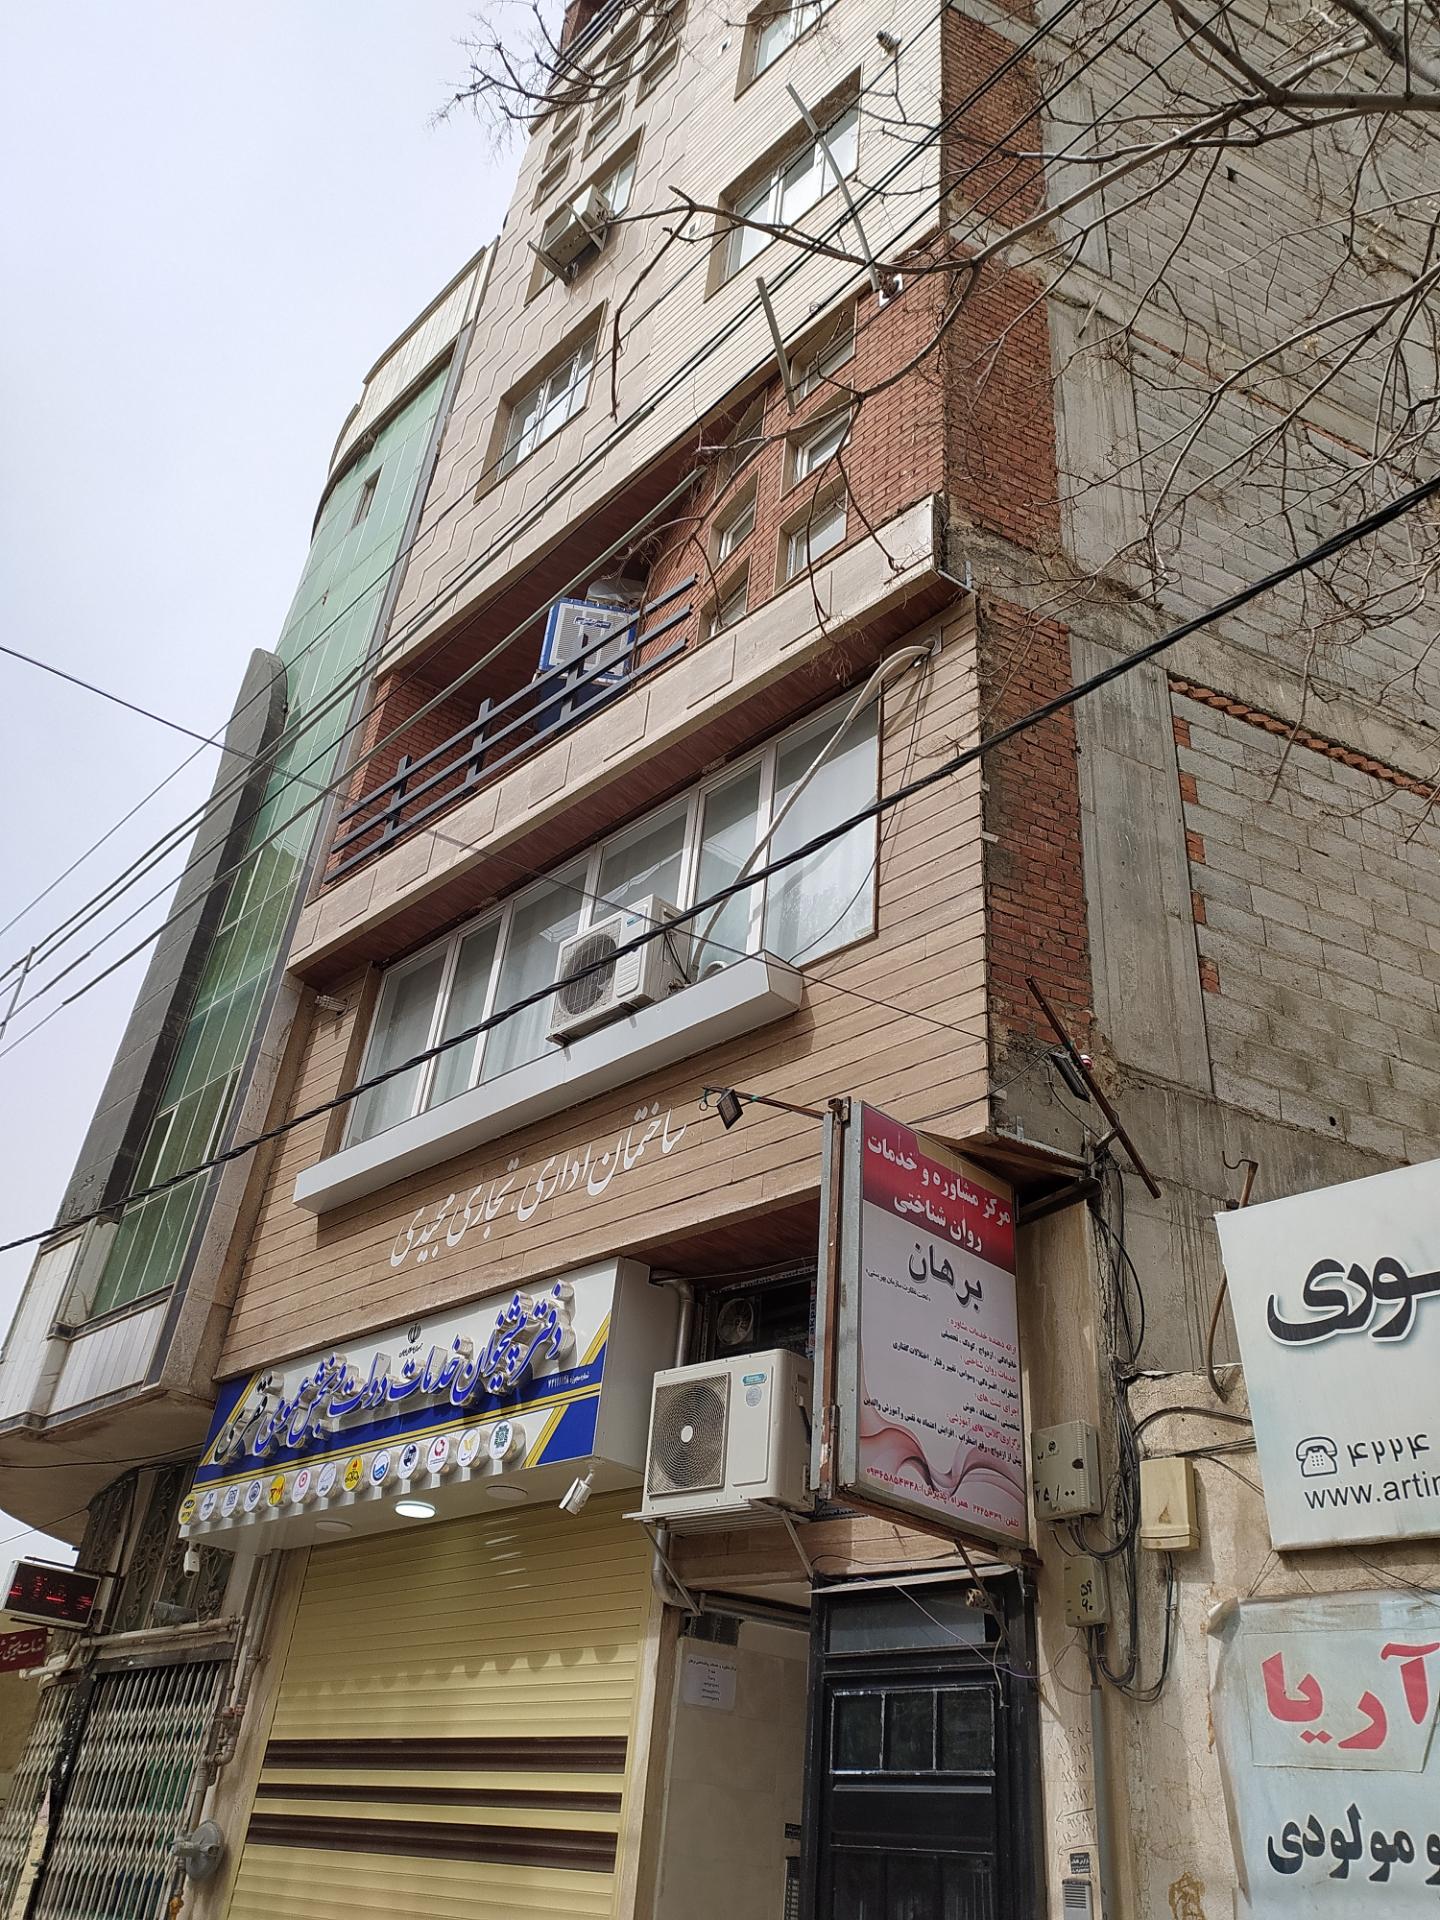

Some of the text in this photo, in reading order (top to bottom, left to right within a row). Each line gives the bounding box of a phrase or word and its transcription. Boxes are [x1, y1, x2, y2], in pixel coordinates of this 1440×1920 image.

[587, 1102, 687, 1197] ساختمان
[867, 1136, 1011, 1226] مرکز مشاوره و خدمات
[446, 1157, 520, 1247] تجاری
[894, 1192, 983, 1252] روان شناختی
[908, 1242, 984, 1311] برهان
[386, 1335, 461, 1401] خدمات
[450, 1291, 529, 1407] پیشخوان
[507, 1281, 564, 1386] دفتر
[969, 1327, 987, 1340] خدمات
[984, 1364, 997, 1377] روان
[286, 1353, 337, 1448] بخش
[327, 1352, 388, 1418] دولت
[998, 1370, 1017, 1383] خدمات
[1003, 1404, 1020, 1417] اجرای
[252, 1377, 309, 1457] عمومی
[951, 1495, 969, 1509] همراه
[1261, 1642, 1440, 1750] آریا
[1267, 1803, 1415, 1882] مولودی
